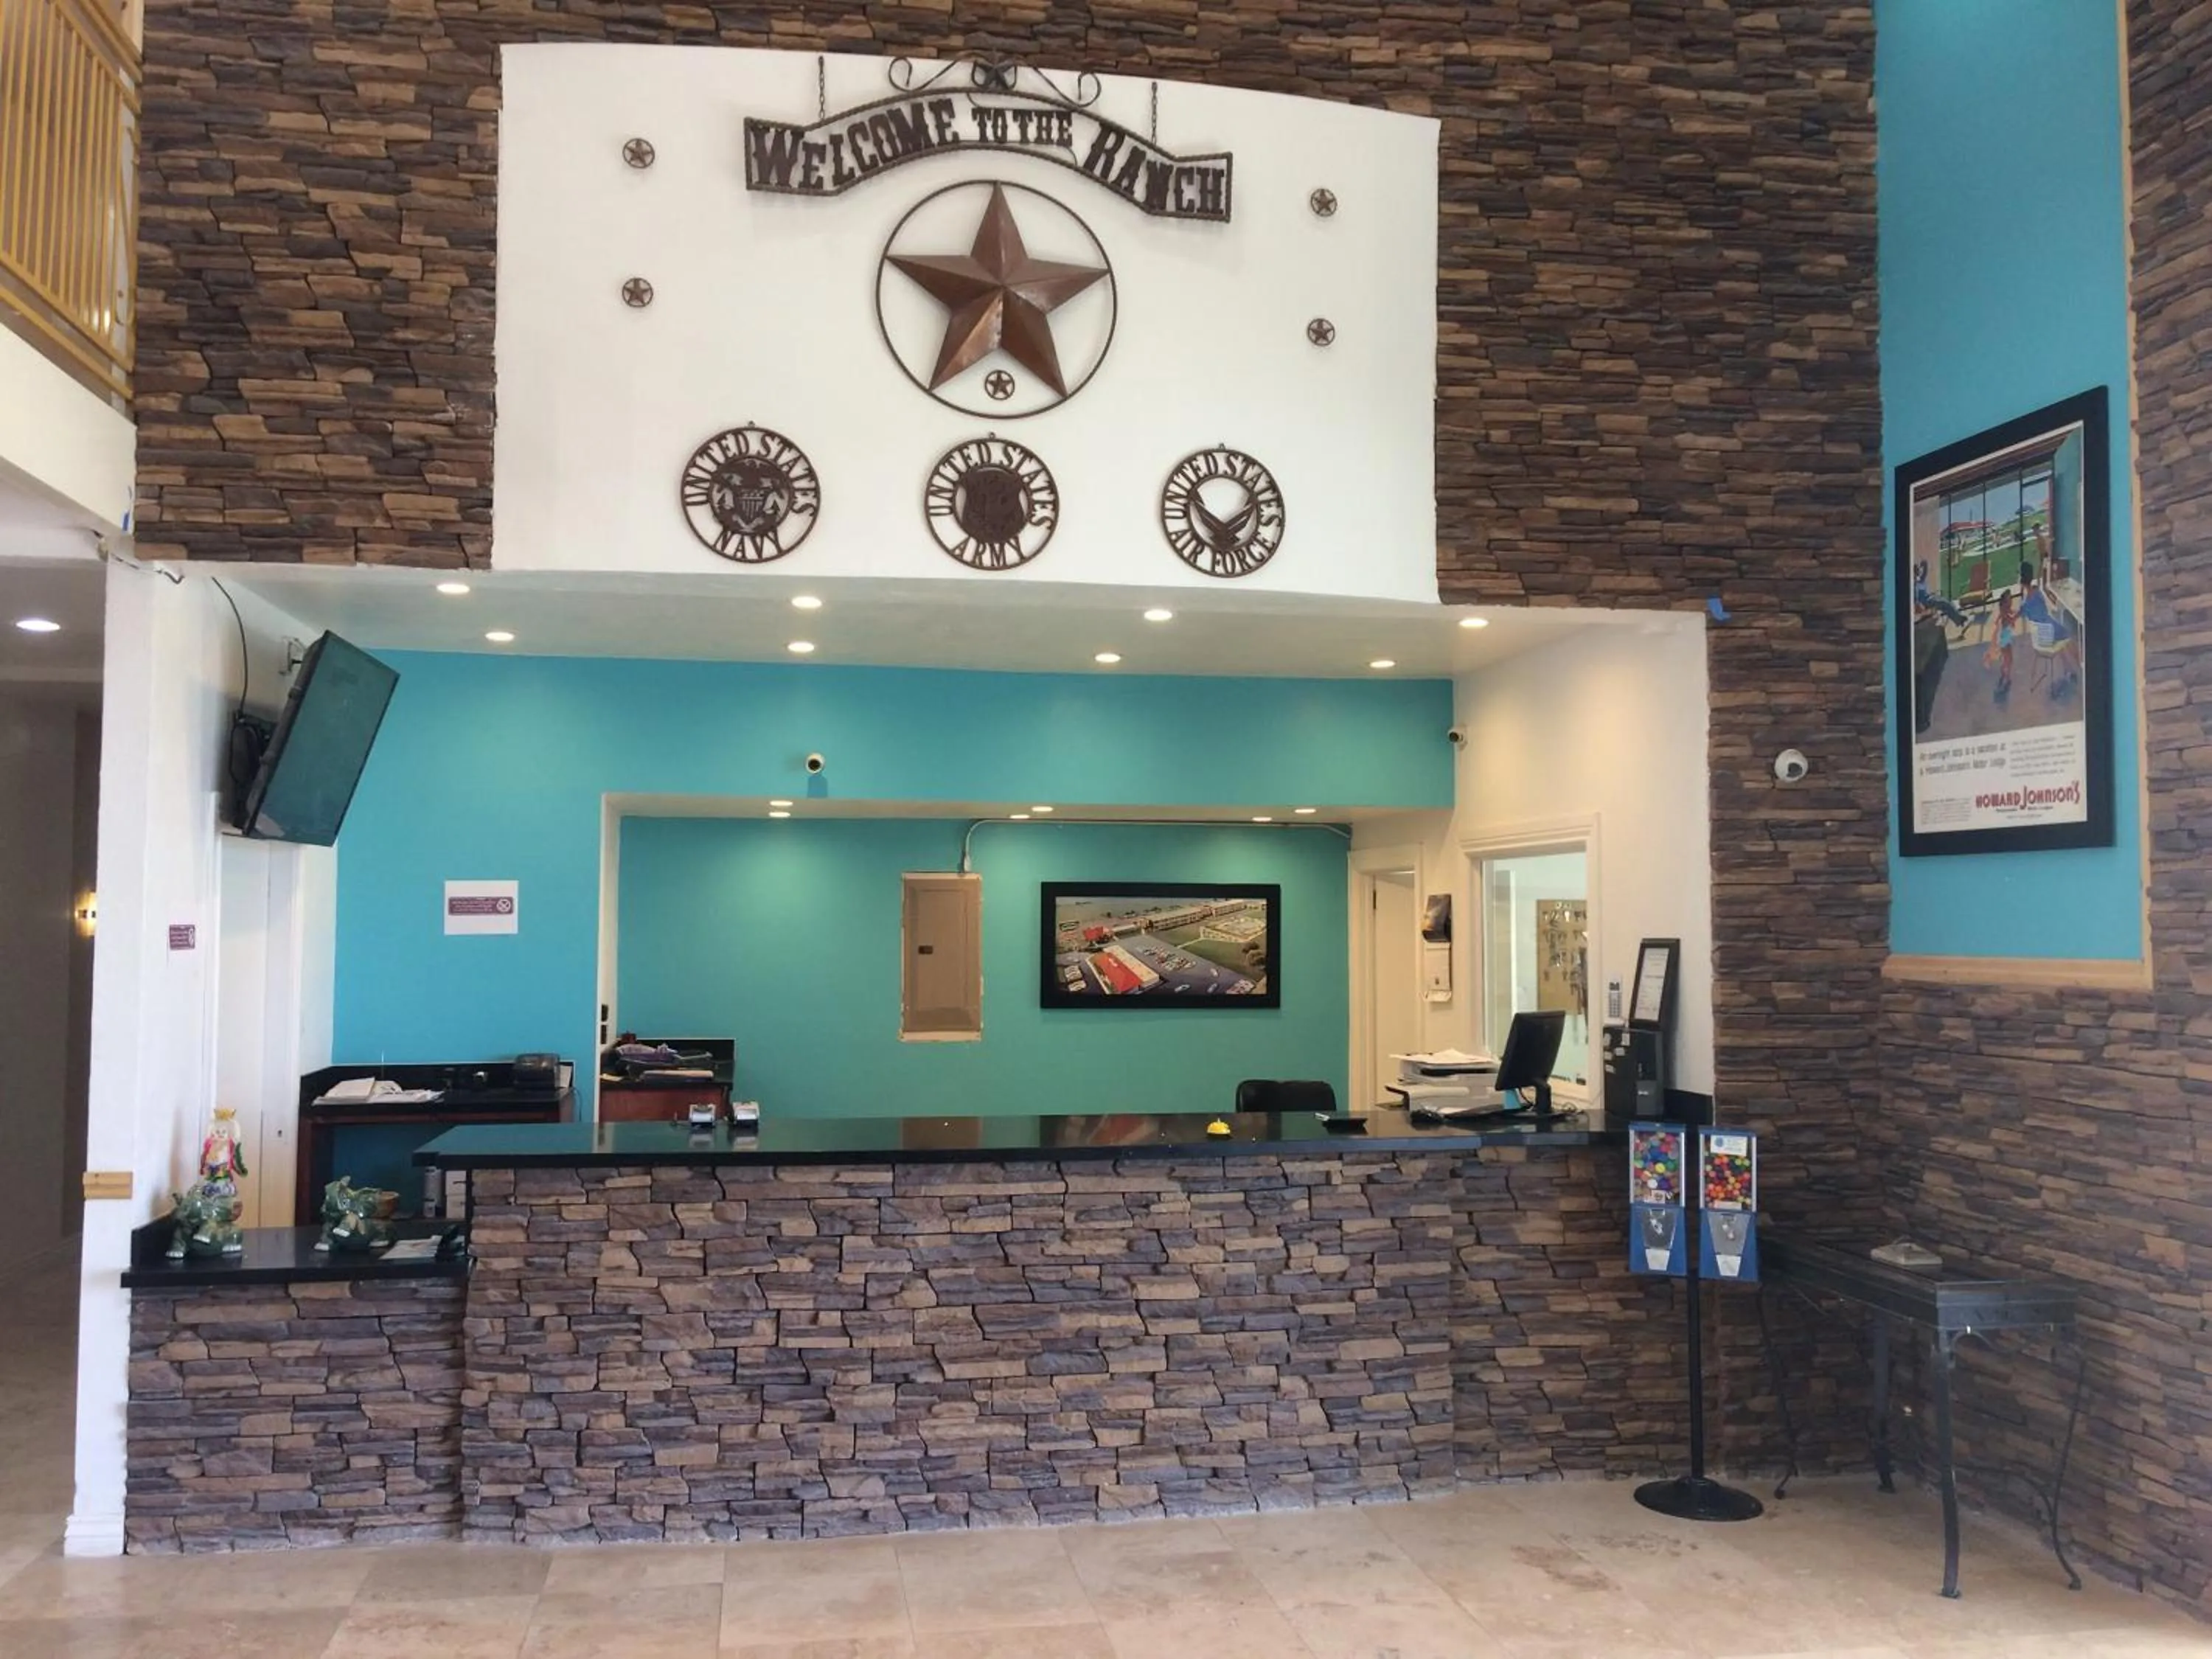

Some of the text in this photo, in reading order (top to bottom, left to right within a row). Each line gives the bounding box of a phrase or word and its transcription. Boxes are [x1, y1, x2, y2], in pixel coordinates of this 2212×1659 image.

[750, 99, 1225, 215] WELCOME TO THE RANCH
[684, 429, 817, 517] UNITED STATES
[928, 442, 1056, 530] UNITED STATES
[1164, 452, 1283, 527] UNITED STATES
[713, 526, 783, 559] NAVY
[950, 536, 1026, 568] ARMY
[1169, 529, 1276, 574] AIR FORCE
[1975, 790, 2021, 809] HOWARD
